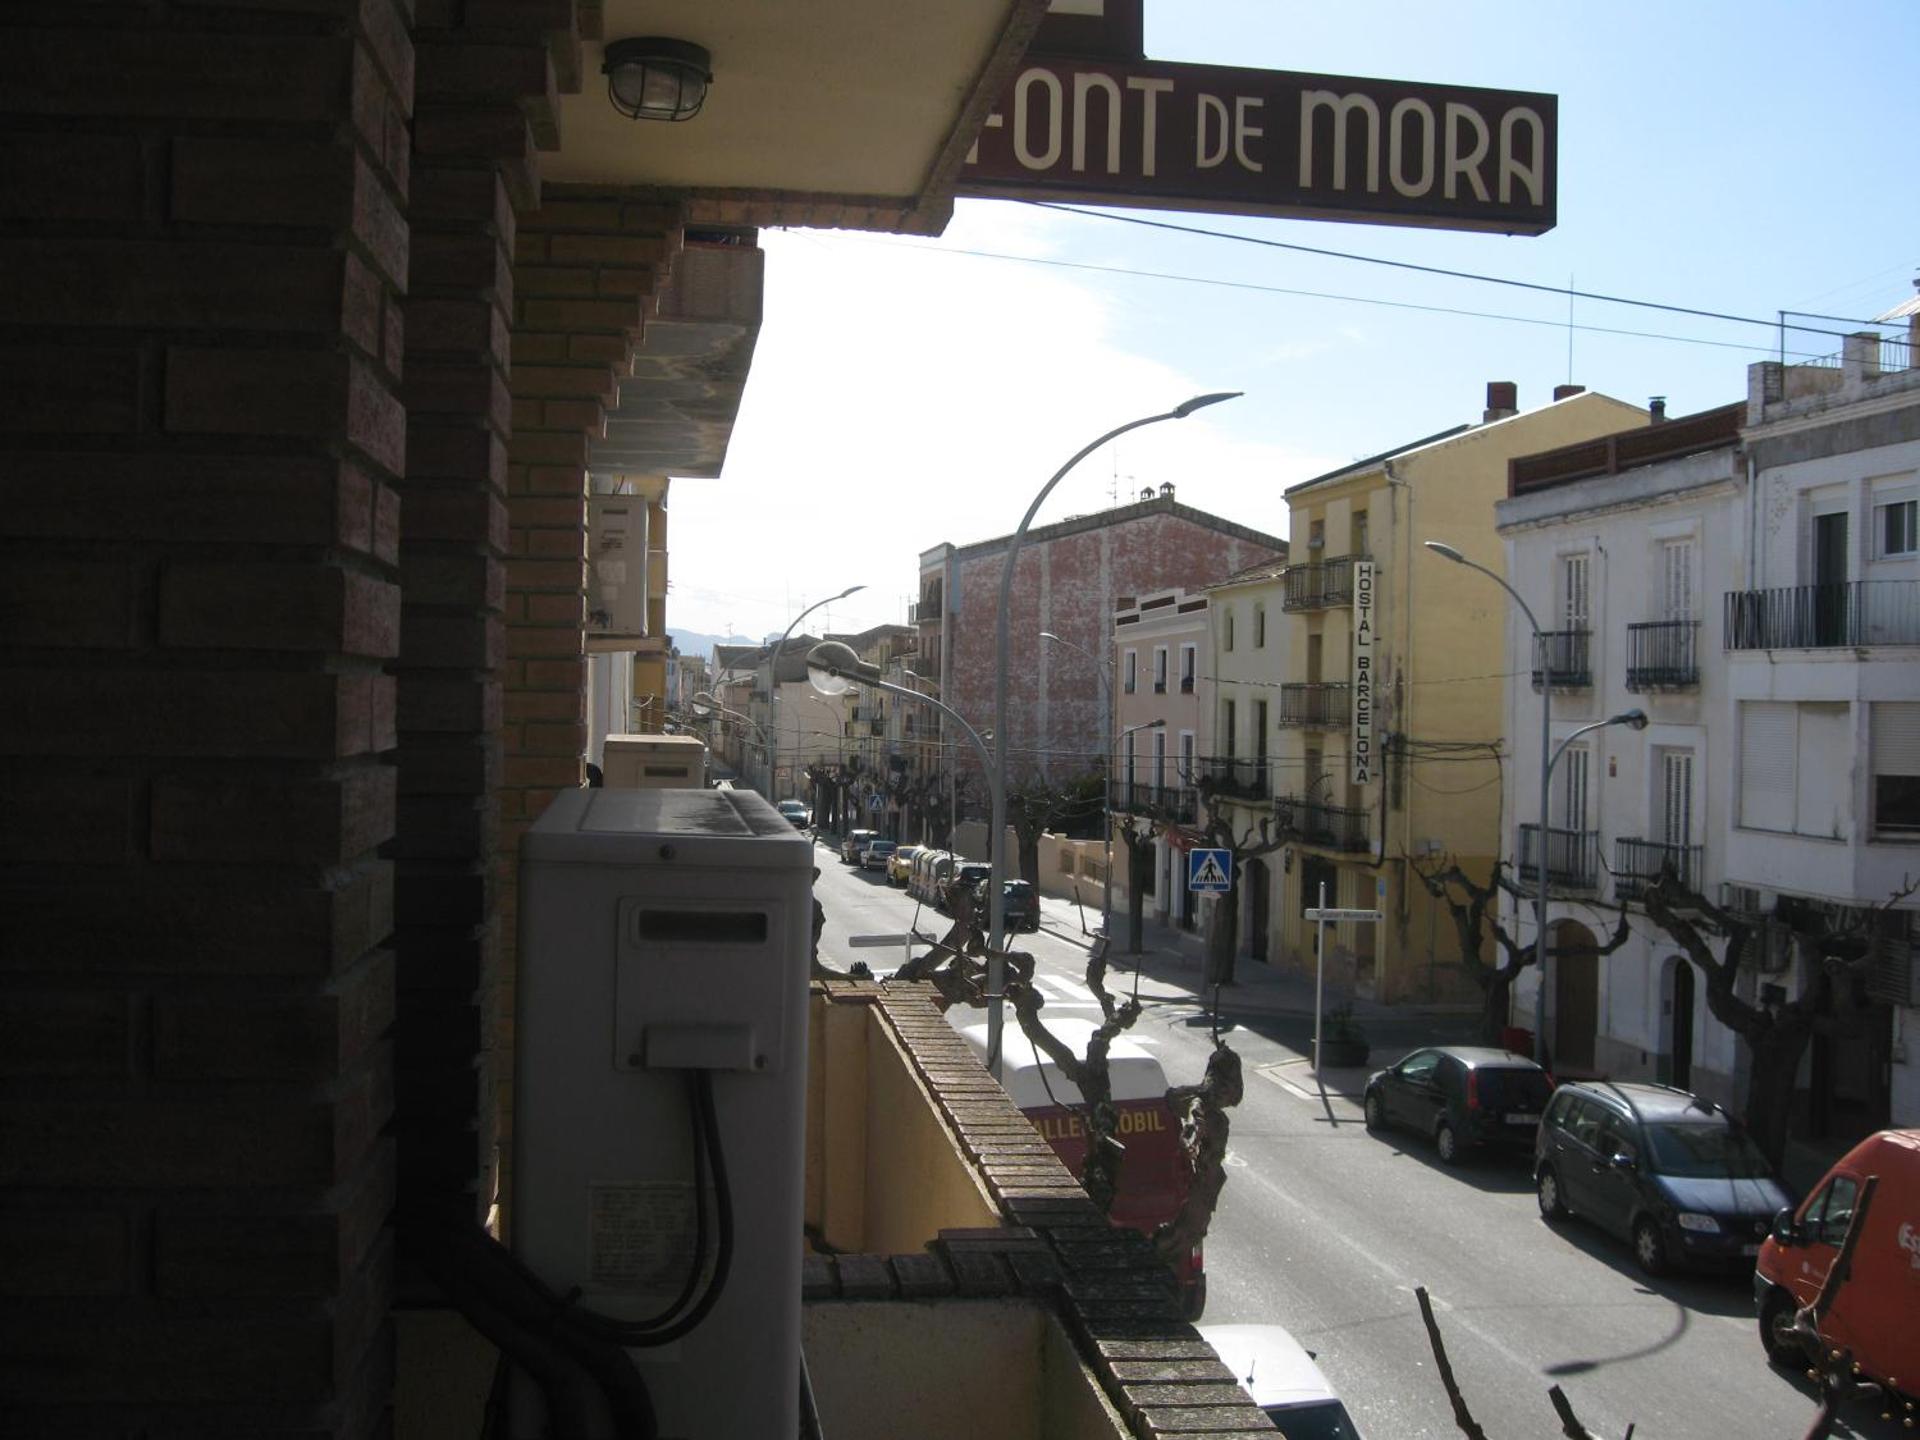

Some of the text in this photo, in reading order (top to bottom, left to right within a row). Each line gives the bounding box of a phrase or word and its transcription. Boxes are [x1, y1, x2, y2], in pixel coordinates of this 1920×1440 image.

[1196, 94, 1263, 173] DE
[1299, 89, 1545, 206] MORA
[1356, 565, 1371, 783] HOSTAL BARCELONA
[1114, 1108, 1166, 1135] ÒBIL
